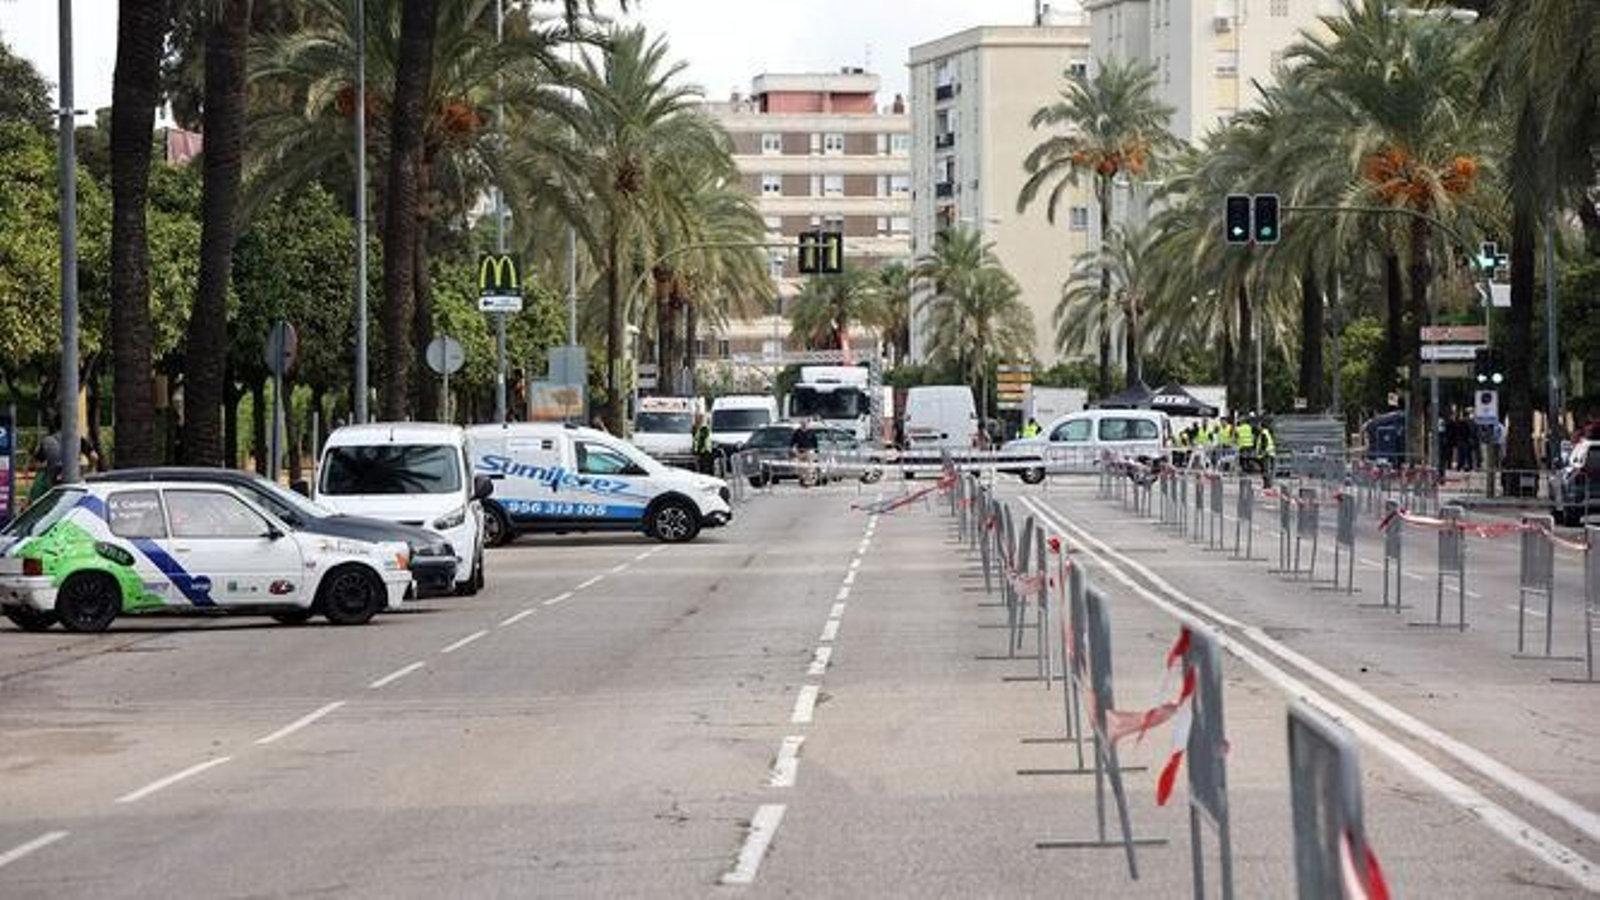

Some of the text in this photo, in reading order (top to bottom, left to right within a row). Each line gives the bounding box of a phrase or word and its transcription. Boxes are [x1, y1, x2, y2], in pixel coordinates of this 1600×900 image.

[508, 501, 608, 516] 956 313 105
